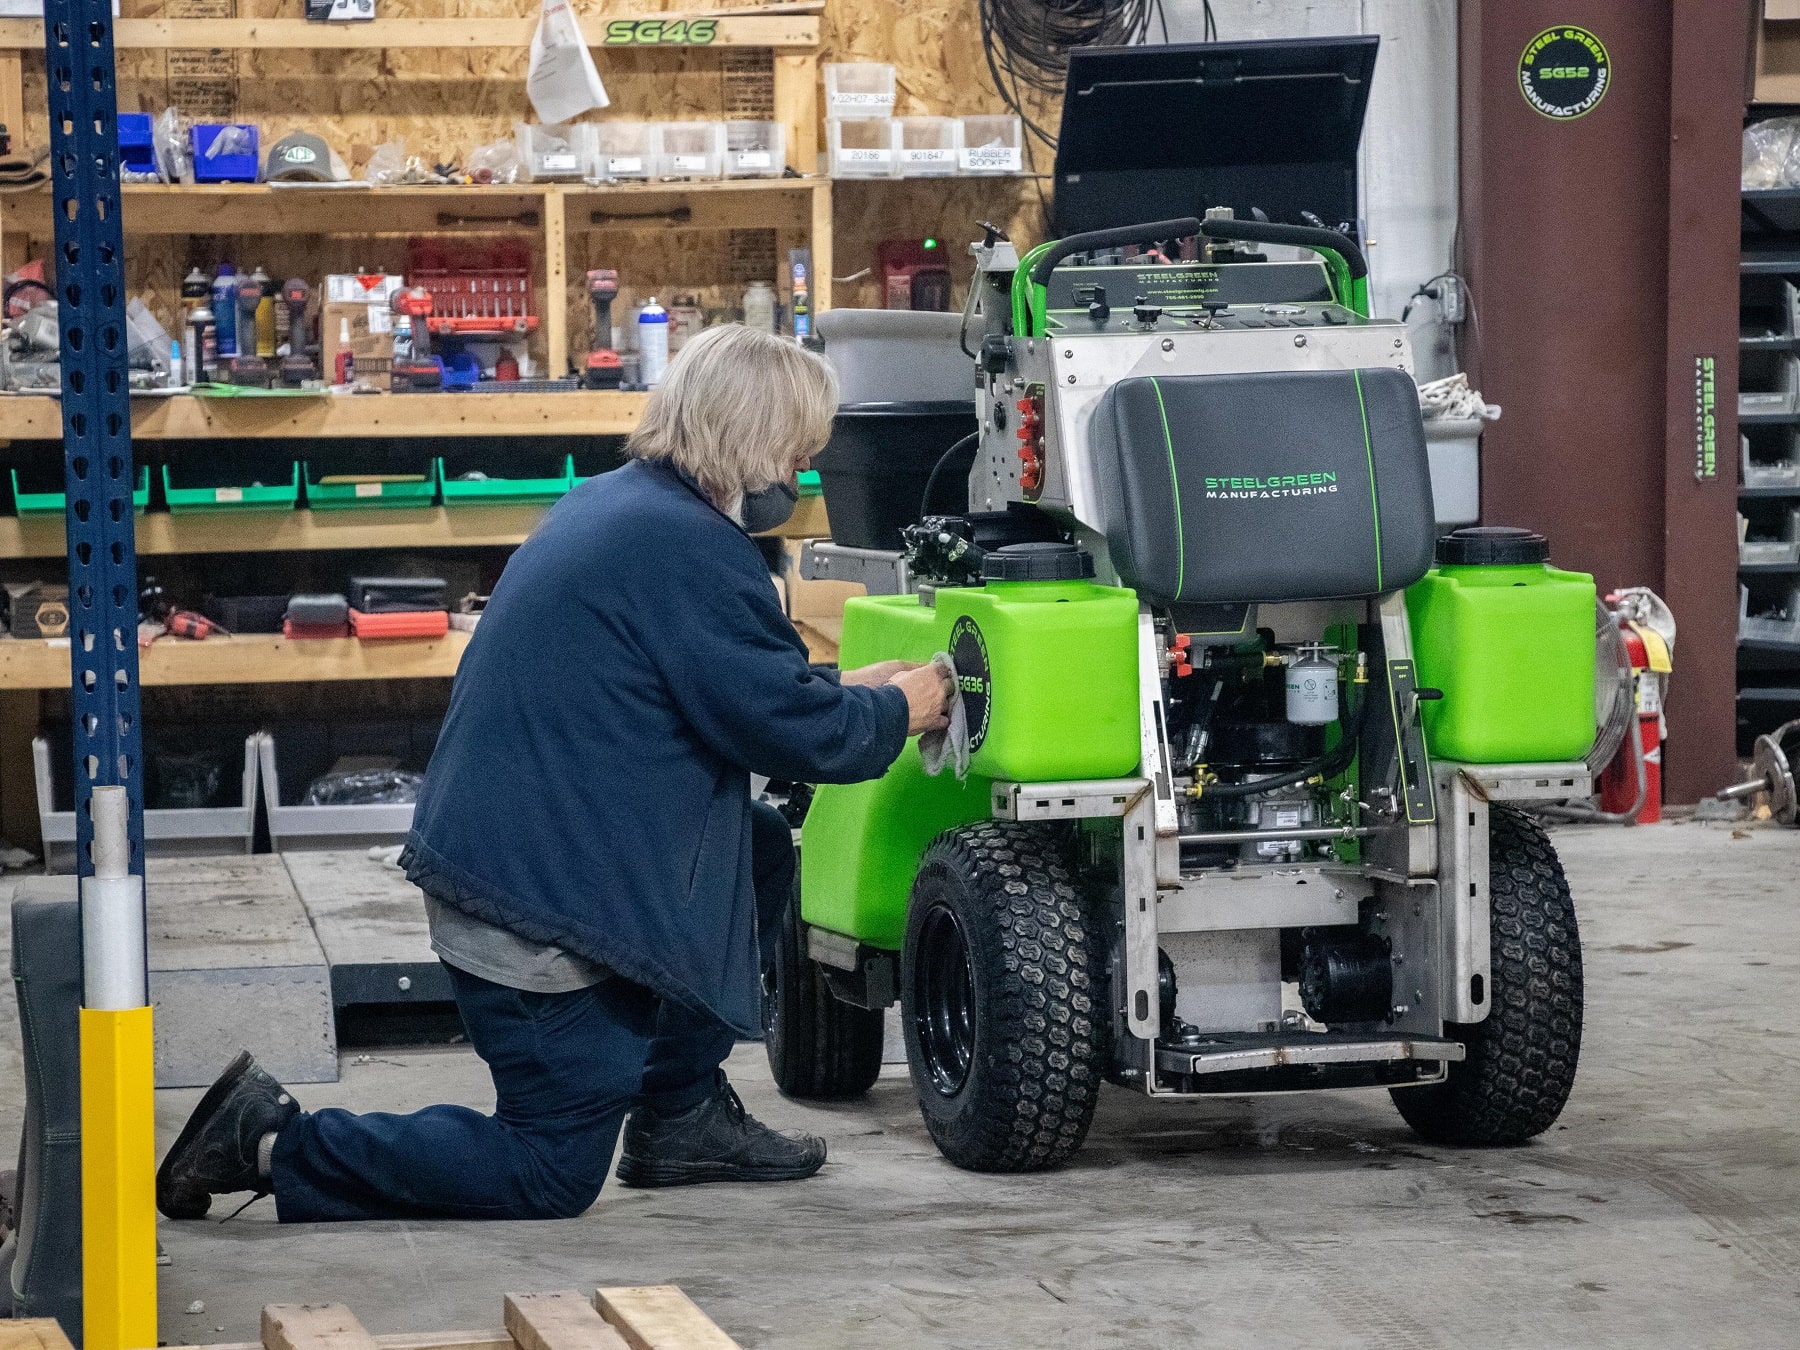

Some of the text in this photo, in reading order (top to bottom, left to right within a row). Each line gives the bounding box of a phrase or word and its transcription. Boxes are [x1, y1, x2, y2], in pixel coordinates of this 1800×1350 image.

[605, 20, 718, 44] SG46
[1524, 30, 1604, 65] STEEL GREEN
[1540, 67, 1590, 79] SG52
[1522, 68, 1606, 115] MANUFACTURING
[911, 151, 944, 160] 901847
[968, 149, 1011, 158] RUBBER
[1137, 272, 1218, 280] STEELGREEN
[1703, 357, 1716, 477] STEELGREEN
[1205, 471, 1337, 489] STEELGREEN
[1206, 484, 1338, 499] MANUFACTURING
[969, 682, 991, 749] CTURING
